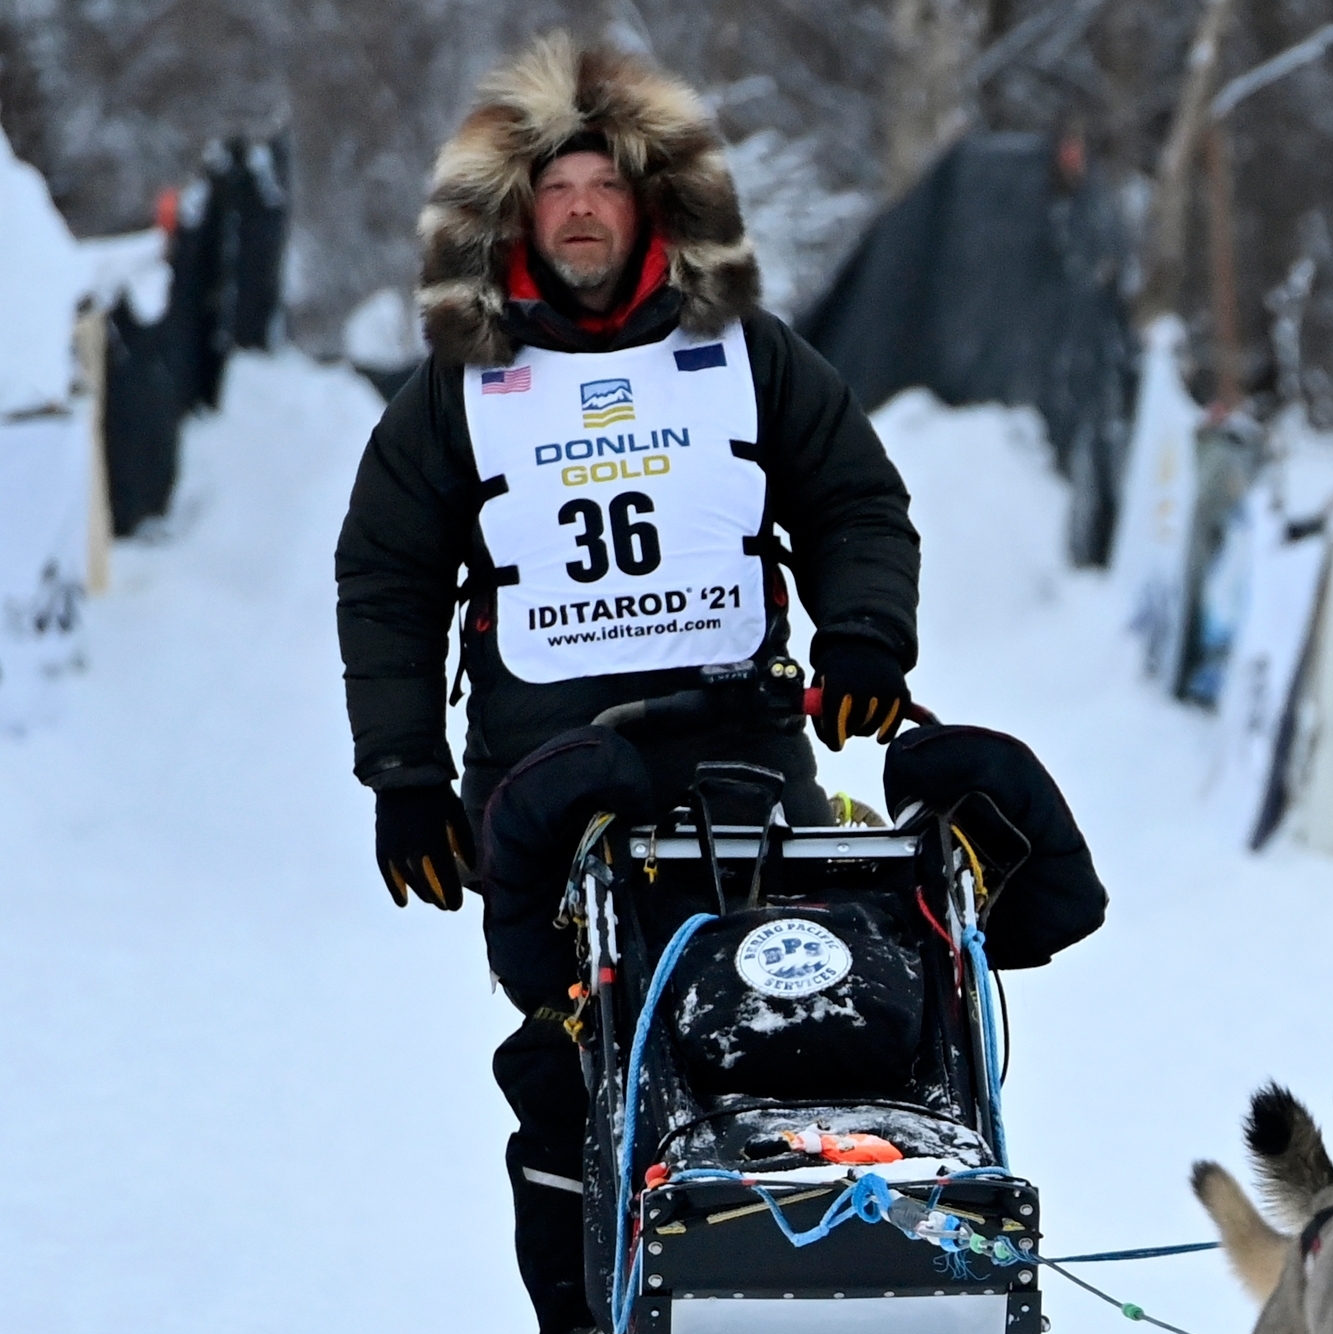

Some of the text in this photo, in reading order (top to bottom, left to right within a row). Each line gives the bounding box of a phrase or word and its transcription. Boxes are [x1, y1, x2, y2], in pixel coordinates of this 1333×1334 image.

[535, 427, 690, 466] DONLIN
[561, 454, 670, 487] GOLD
[557, 491, 661, 583] 36
[547, 616, 721, 647] www.iditarod.com
[744, 923, 839, 960] BERING PACIFIC
[764, 967, 837, 991] SERVICES
